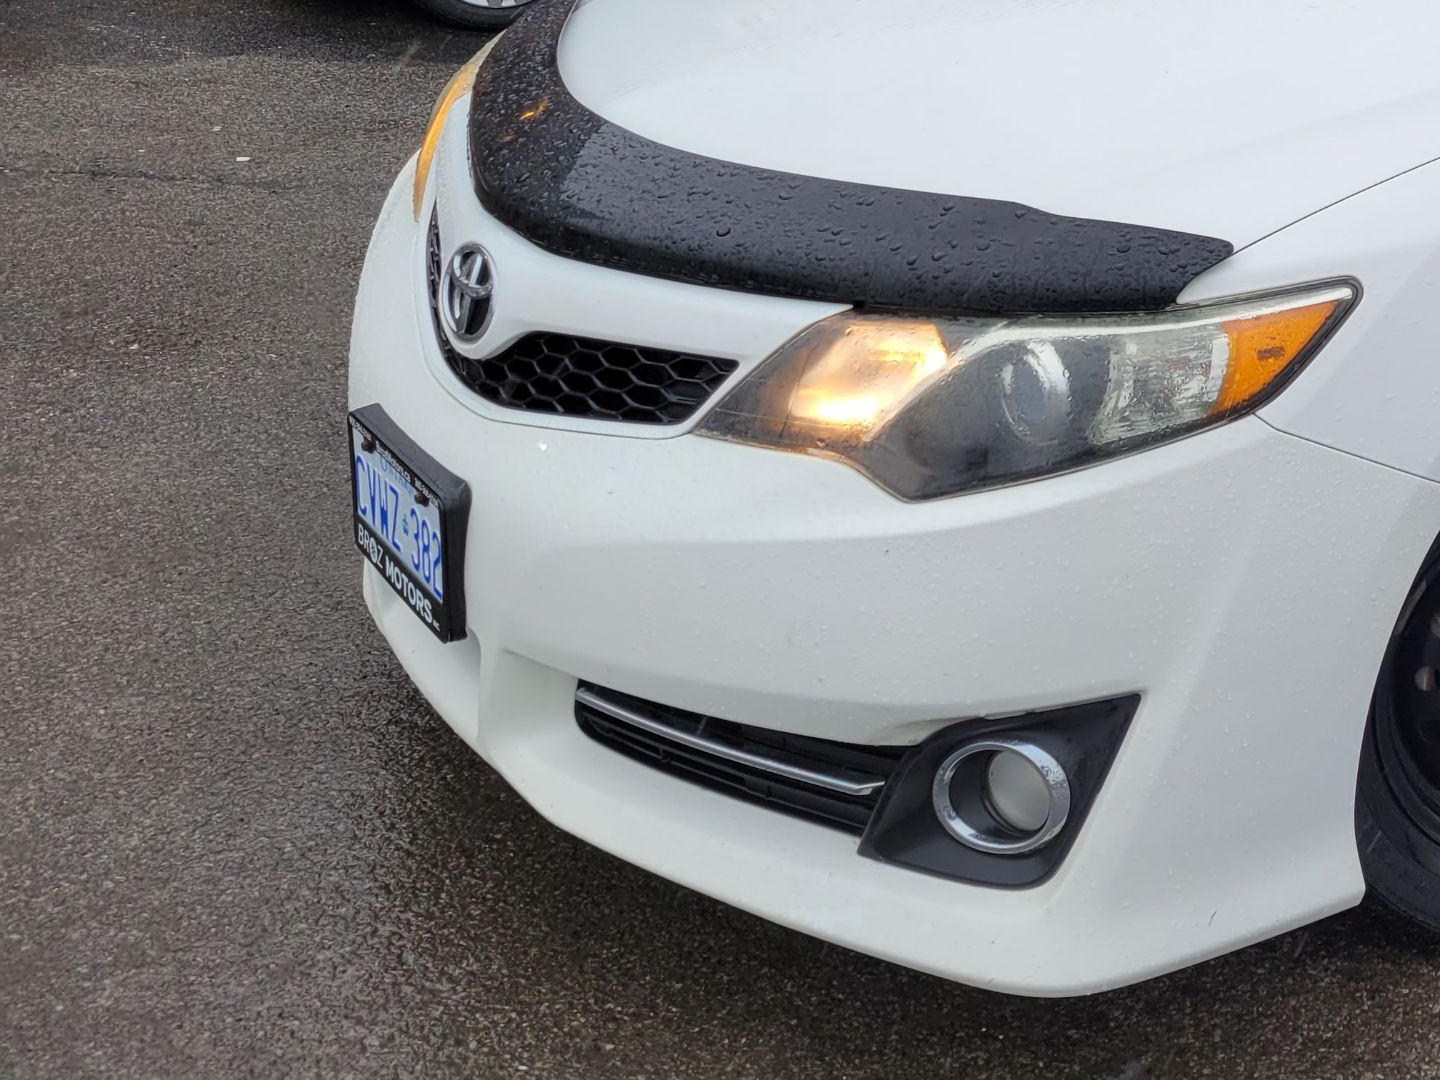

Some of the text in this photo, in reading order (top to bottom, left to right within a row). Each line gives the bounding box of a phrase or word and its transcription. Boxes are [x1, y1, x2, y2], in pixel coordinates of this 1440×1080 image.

[356, 455, 402, 553] CVWZ
[410, 507, 442, 600] 382
[358, 523, 433, 624] BROZ MOTORS
